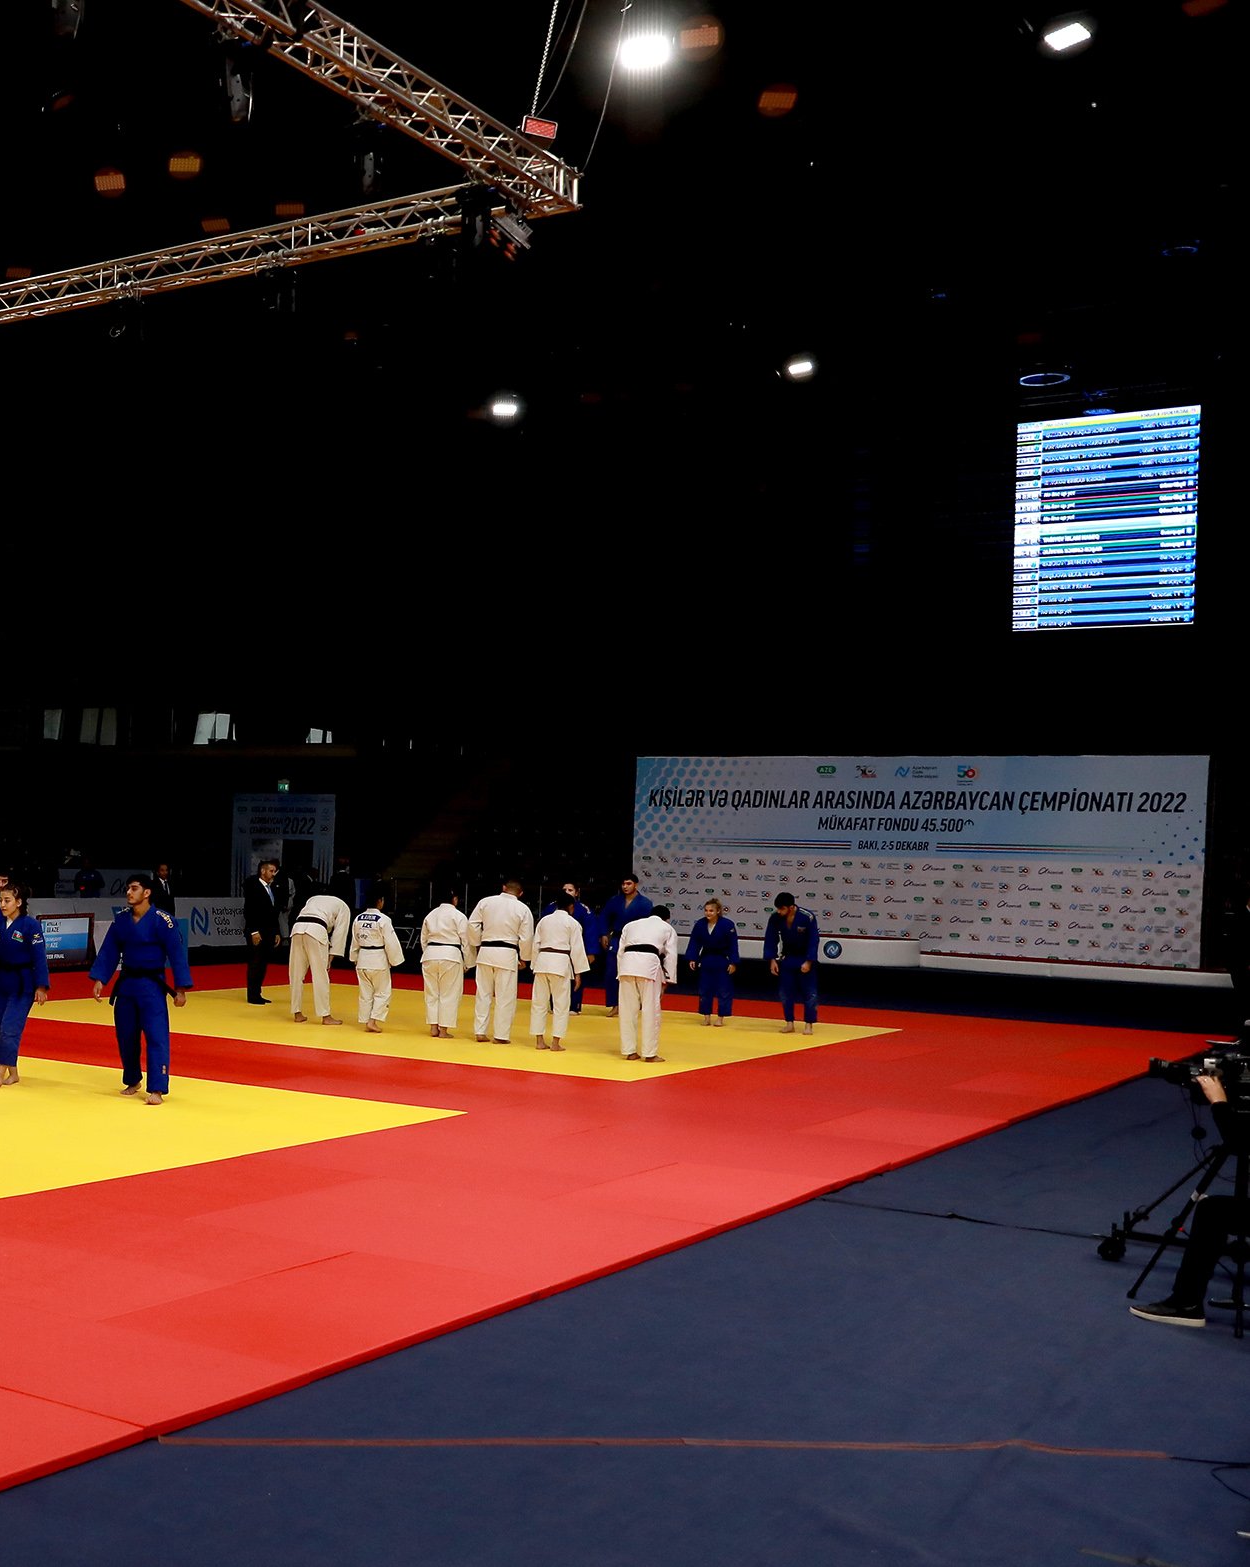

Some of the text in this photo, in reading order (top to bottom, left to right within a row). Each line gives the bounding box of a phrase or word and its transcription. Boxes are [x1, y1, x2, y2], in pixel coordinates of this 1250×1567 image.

[648, 786, 1187, 815] KİŞİLƏR VƏ QADINLAR ARASINDA AZƏRBAYCAN ÇEMPİONATI 2022
[283, 817, 315, 835] 2022
[818, 815, 875, 831] MÜKAFAT
[877, 817, 920, 832] FONDU
[881, 841, 894, 851] 2-5
[896, 841, 929, 851] DEKABR
